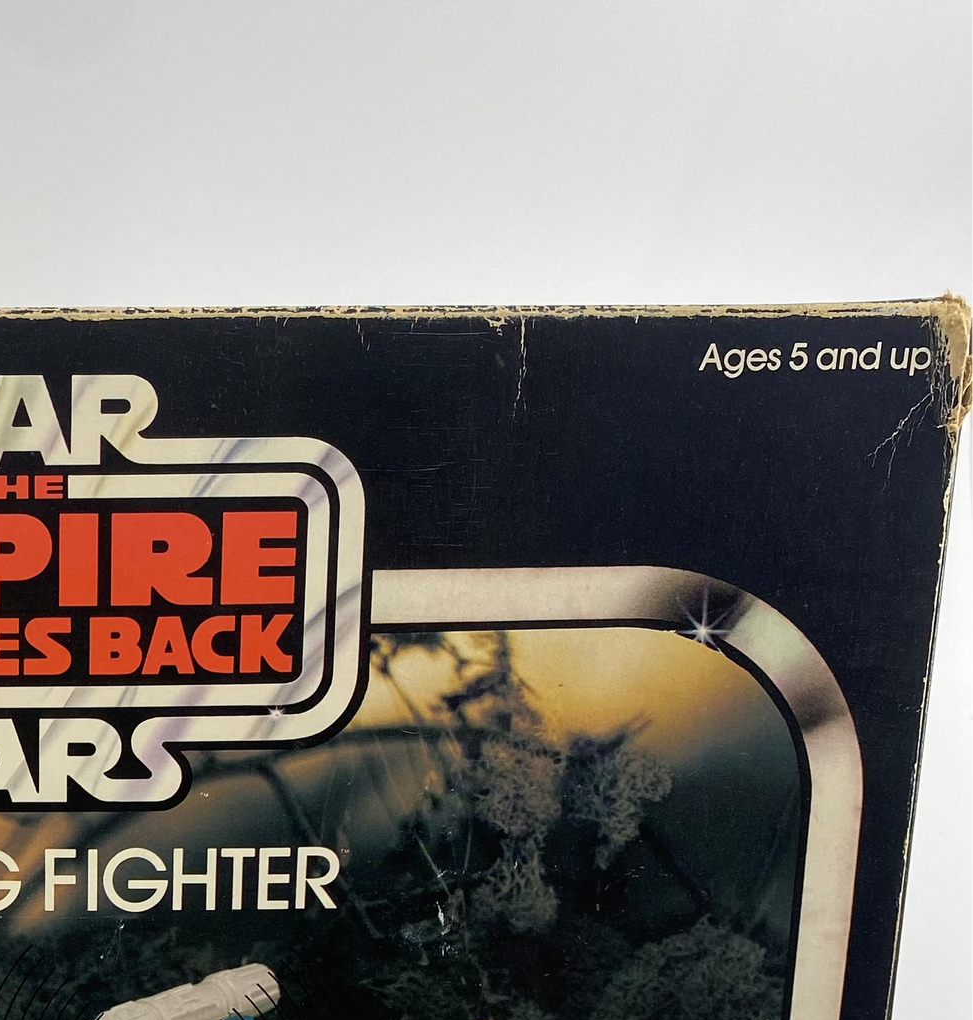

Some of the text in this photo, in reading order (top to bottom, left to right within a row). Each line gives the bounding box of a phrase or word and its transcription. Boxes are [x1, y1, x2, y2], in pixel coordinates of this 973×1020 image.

[698, 341, 932, 379] Ages 5 and up
[89, 614, 294, 675] BACK
[44, 846, 341, 912] FIGHTER
